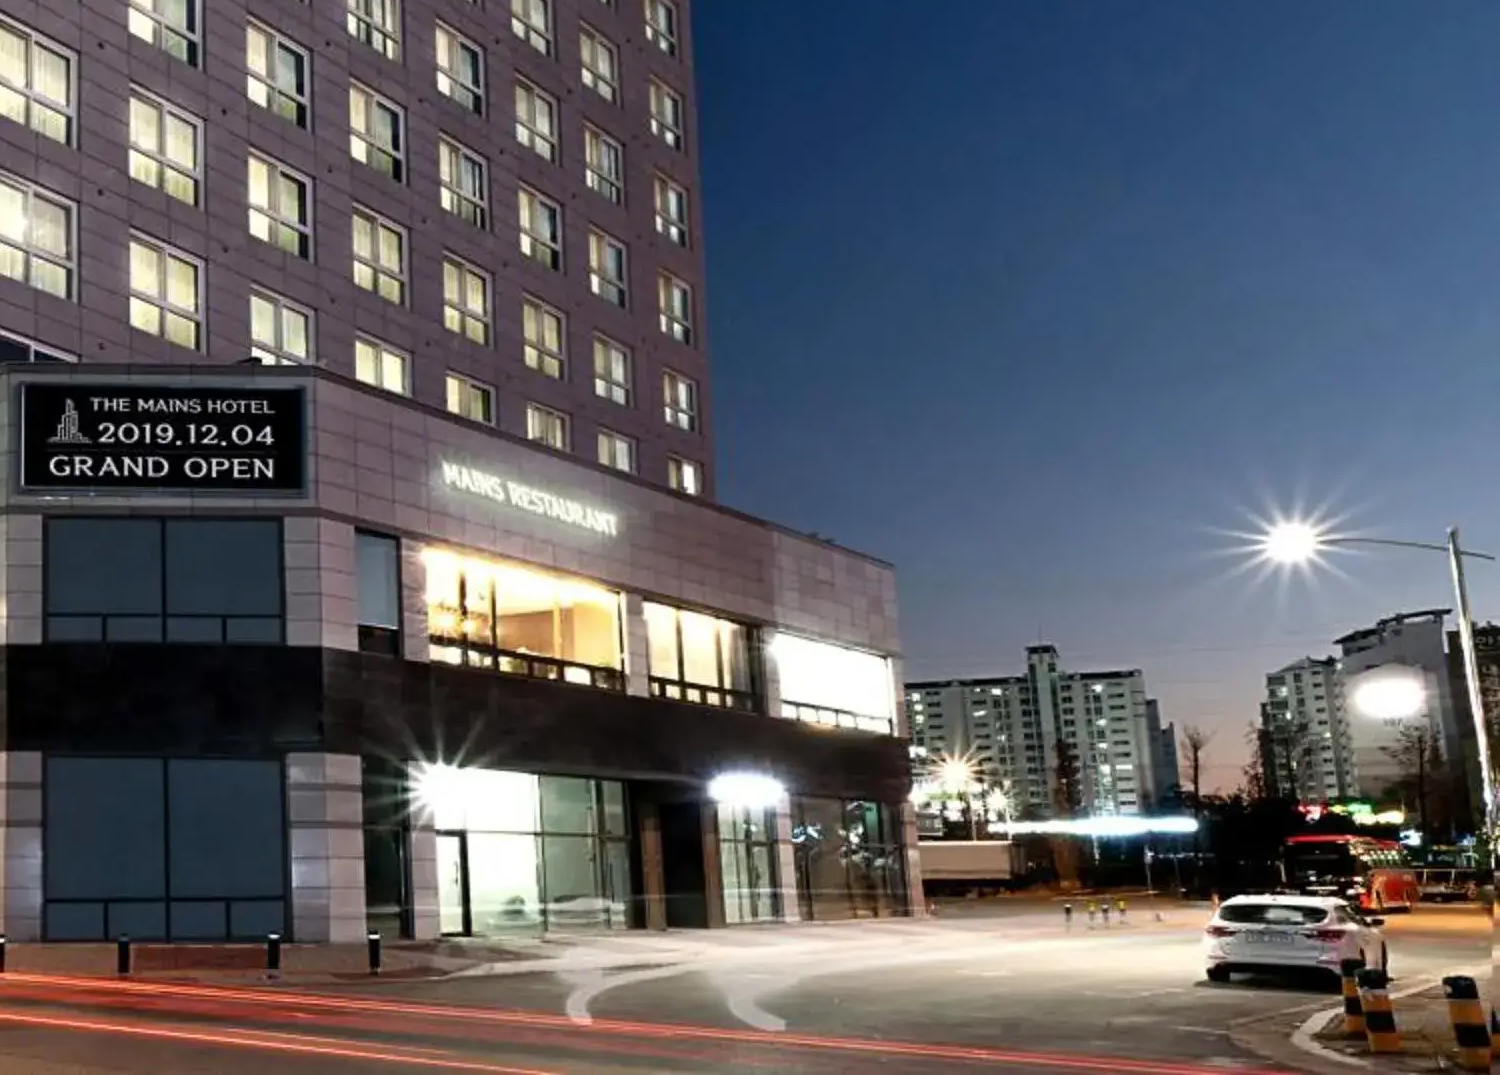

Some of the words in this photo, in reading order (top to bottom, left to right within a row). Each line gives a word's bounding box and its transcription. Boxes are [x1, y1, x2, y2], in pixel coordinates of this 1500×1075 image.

[90, 396, 130, 412] THE
[137, 398, 201, 413] MAINS
[207, 399, 276, 414] HOTEL
[97, 422, 275, 446] 2019.12.04
[49, 455, 169, 477] GRAND
[183, 457, 274, 479] OPEN
[441, 460, 506, 502] MAINS
[506, 480, 618, 537] RESTAURANT
